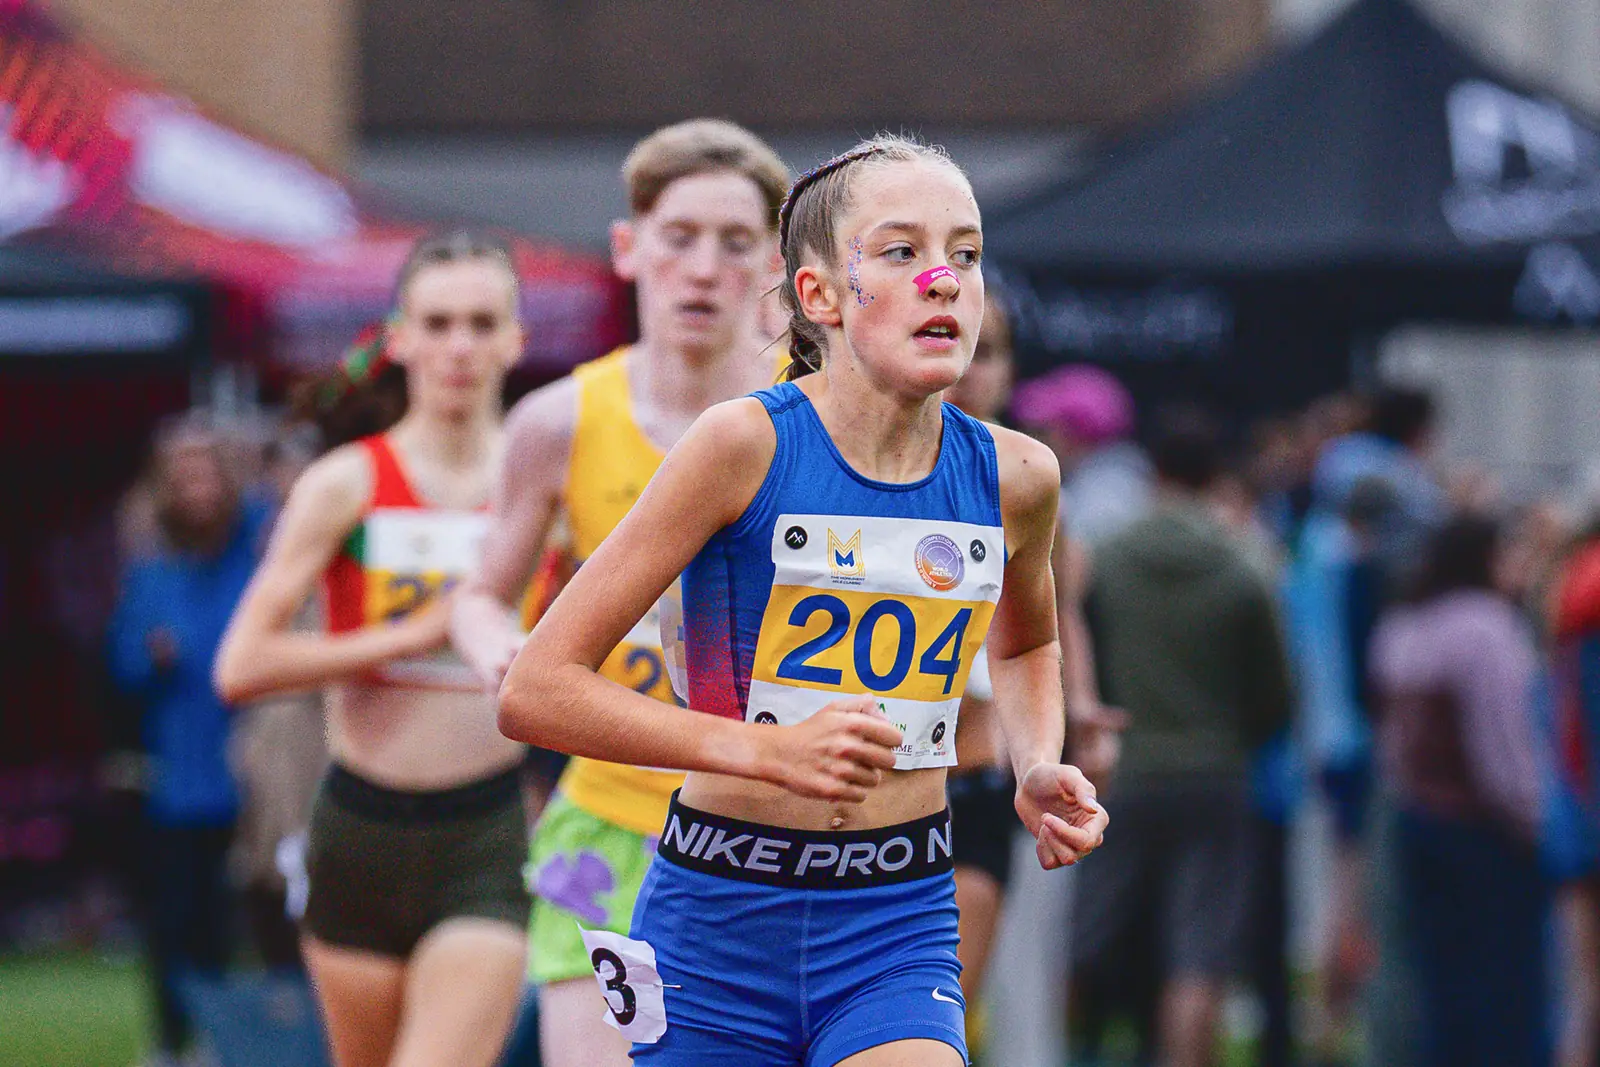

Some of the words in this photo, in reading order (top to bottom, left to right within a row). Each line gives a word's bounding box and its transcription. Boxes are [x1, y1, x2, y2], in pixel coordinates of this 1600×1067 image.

[776, 594, 973, 695] 204
[663, 813, 791, 873] NIKE
[794, 836, 914, 877] PRO
[591, 947, 637, 1026] 3
